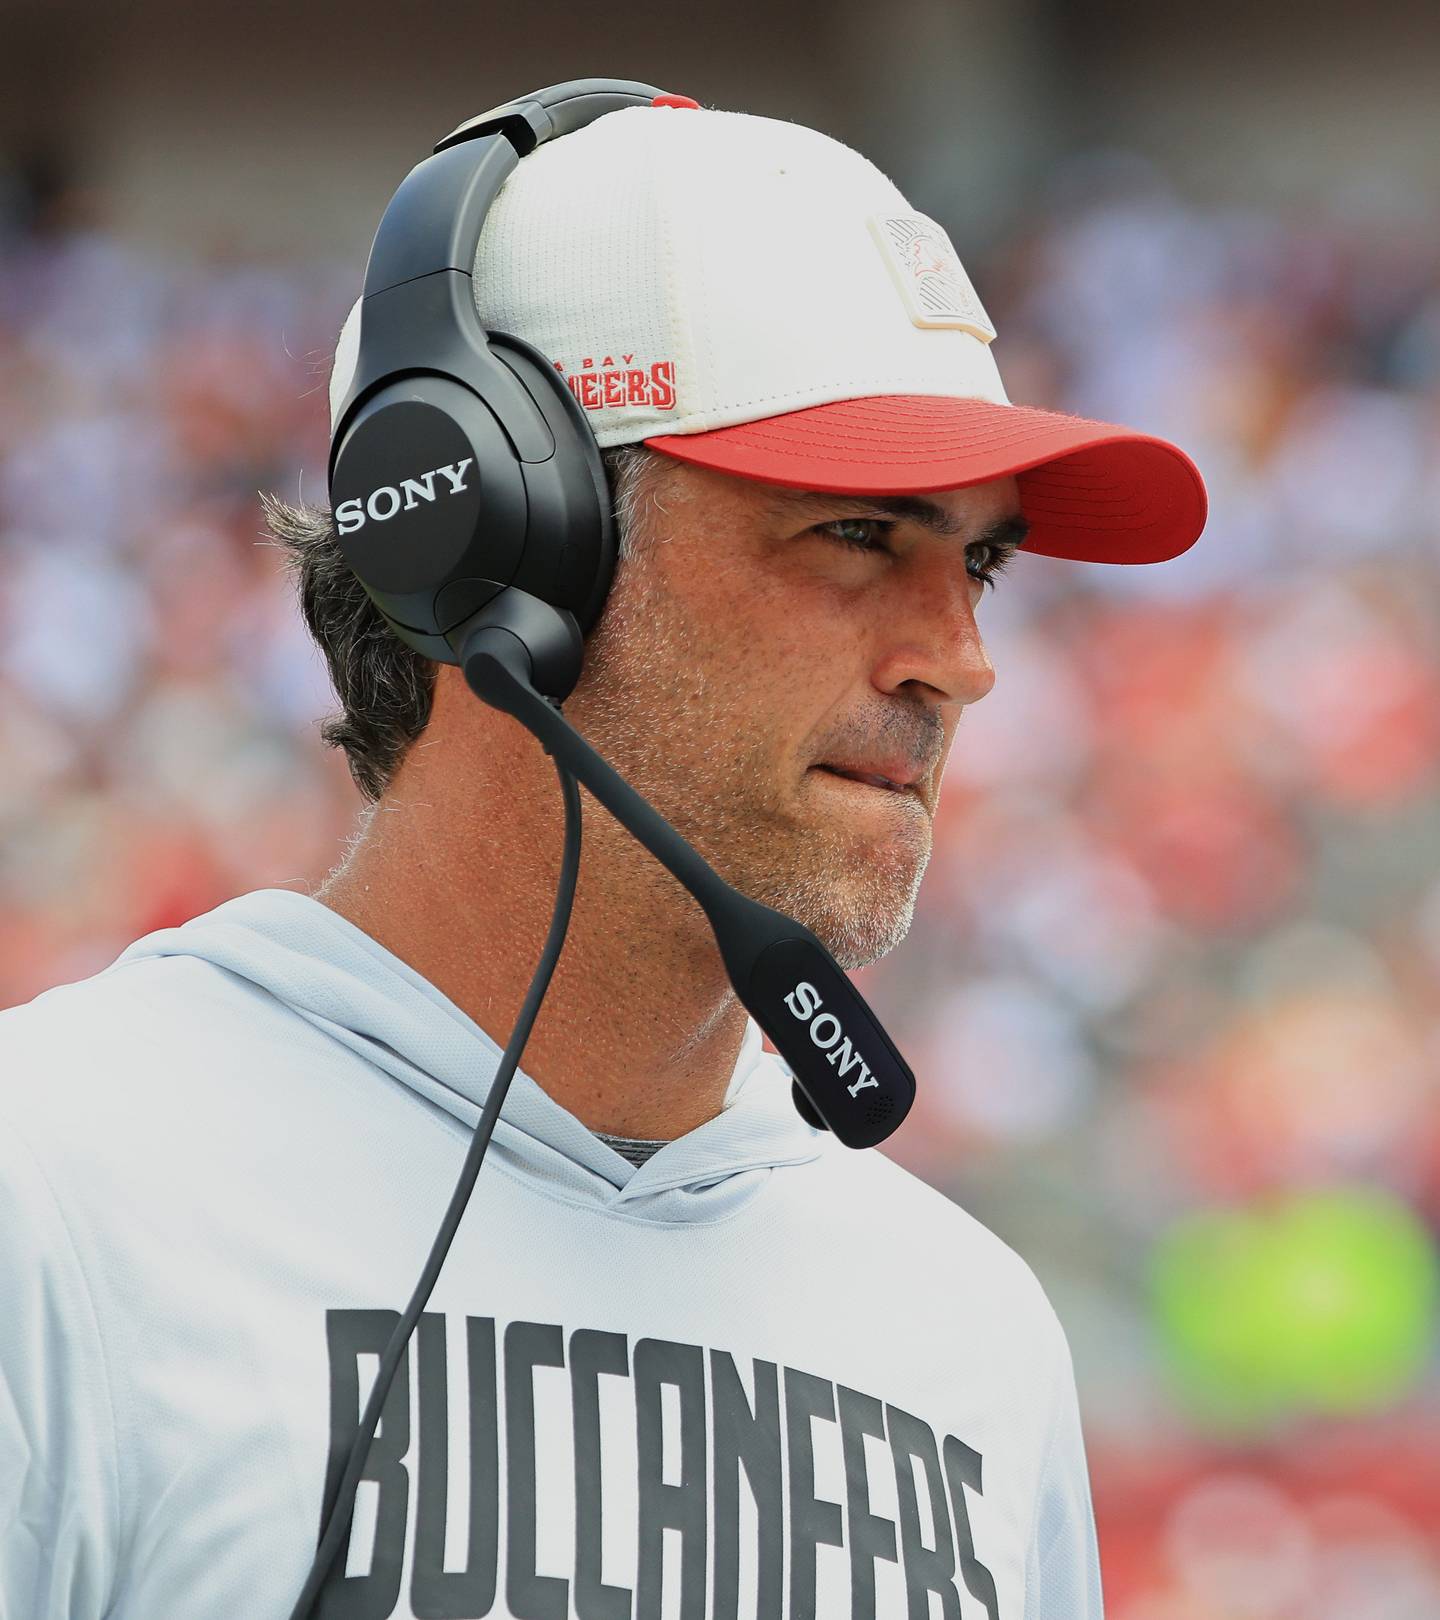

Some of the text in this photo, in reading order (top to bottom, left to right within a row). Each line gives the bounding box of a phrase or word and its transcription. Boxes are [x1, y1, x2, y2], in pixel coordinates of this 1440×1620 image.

[334, 456, 474, 536] SONY
[783, 981, 880, 1099] SONY
[318, 1308, 1000, 1620] BUCCANEERS
